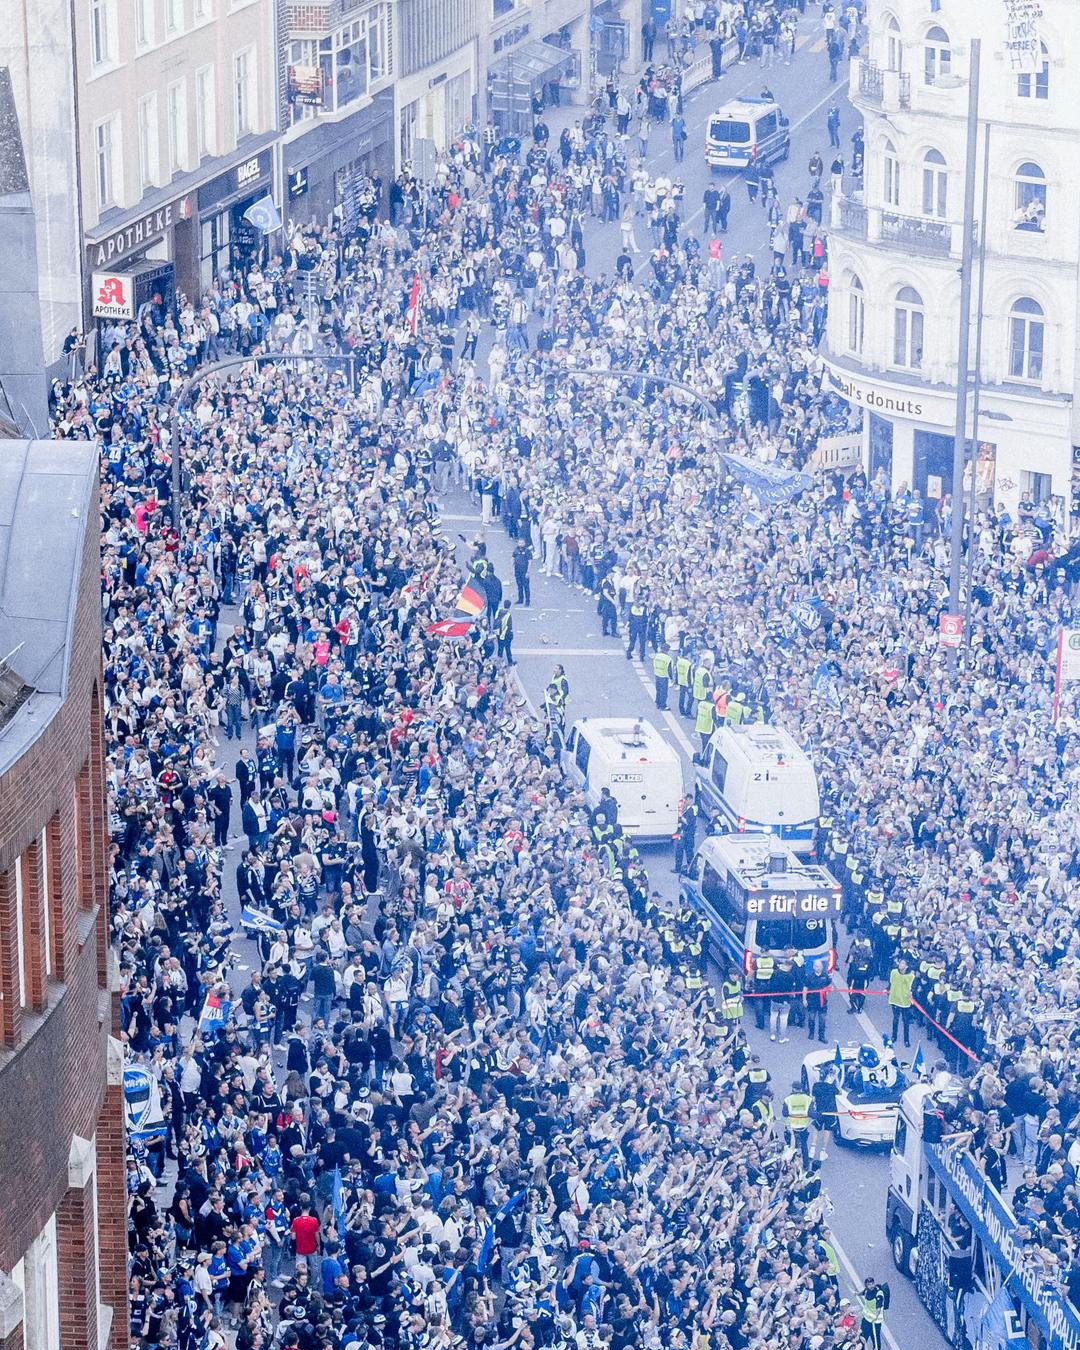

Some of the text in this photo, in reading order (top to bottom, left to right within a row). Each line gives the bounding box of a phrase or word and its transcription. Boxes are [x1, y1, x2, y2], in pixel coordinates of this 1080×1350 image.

[97, 205, 173, 266] APOTHEKE
[95, 305, 131, 317] APOTHEKE
[866, 391, 923, 415] donuts
[611, 774, 643, 782] POLIZEI
[747, 898, 769, 913] er
[769, 895, 794, 913] für
[801, 894, 828, 912] die
